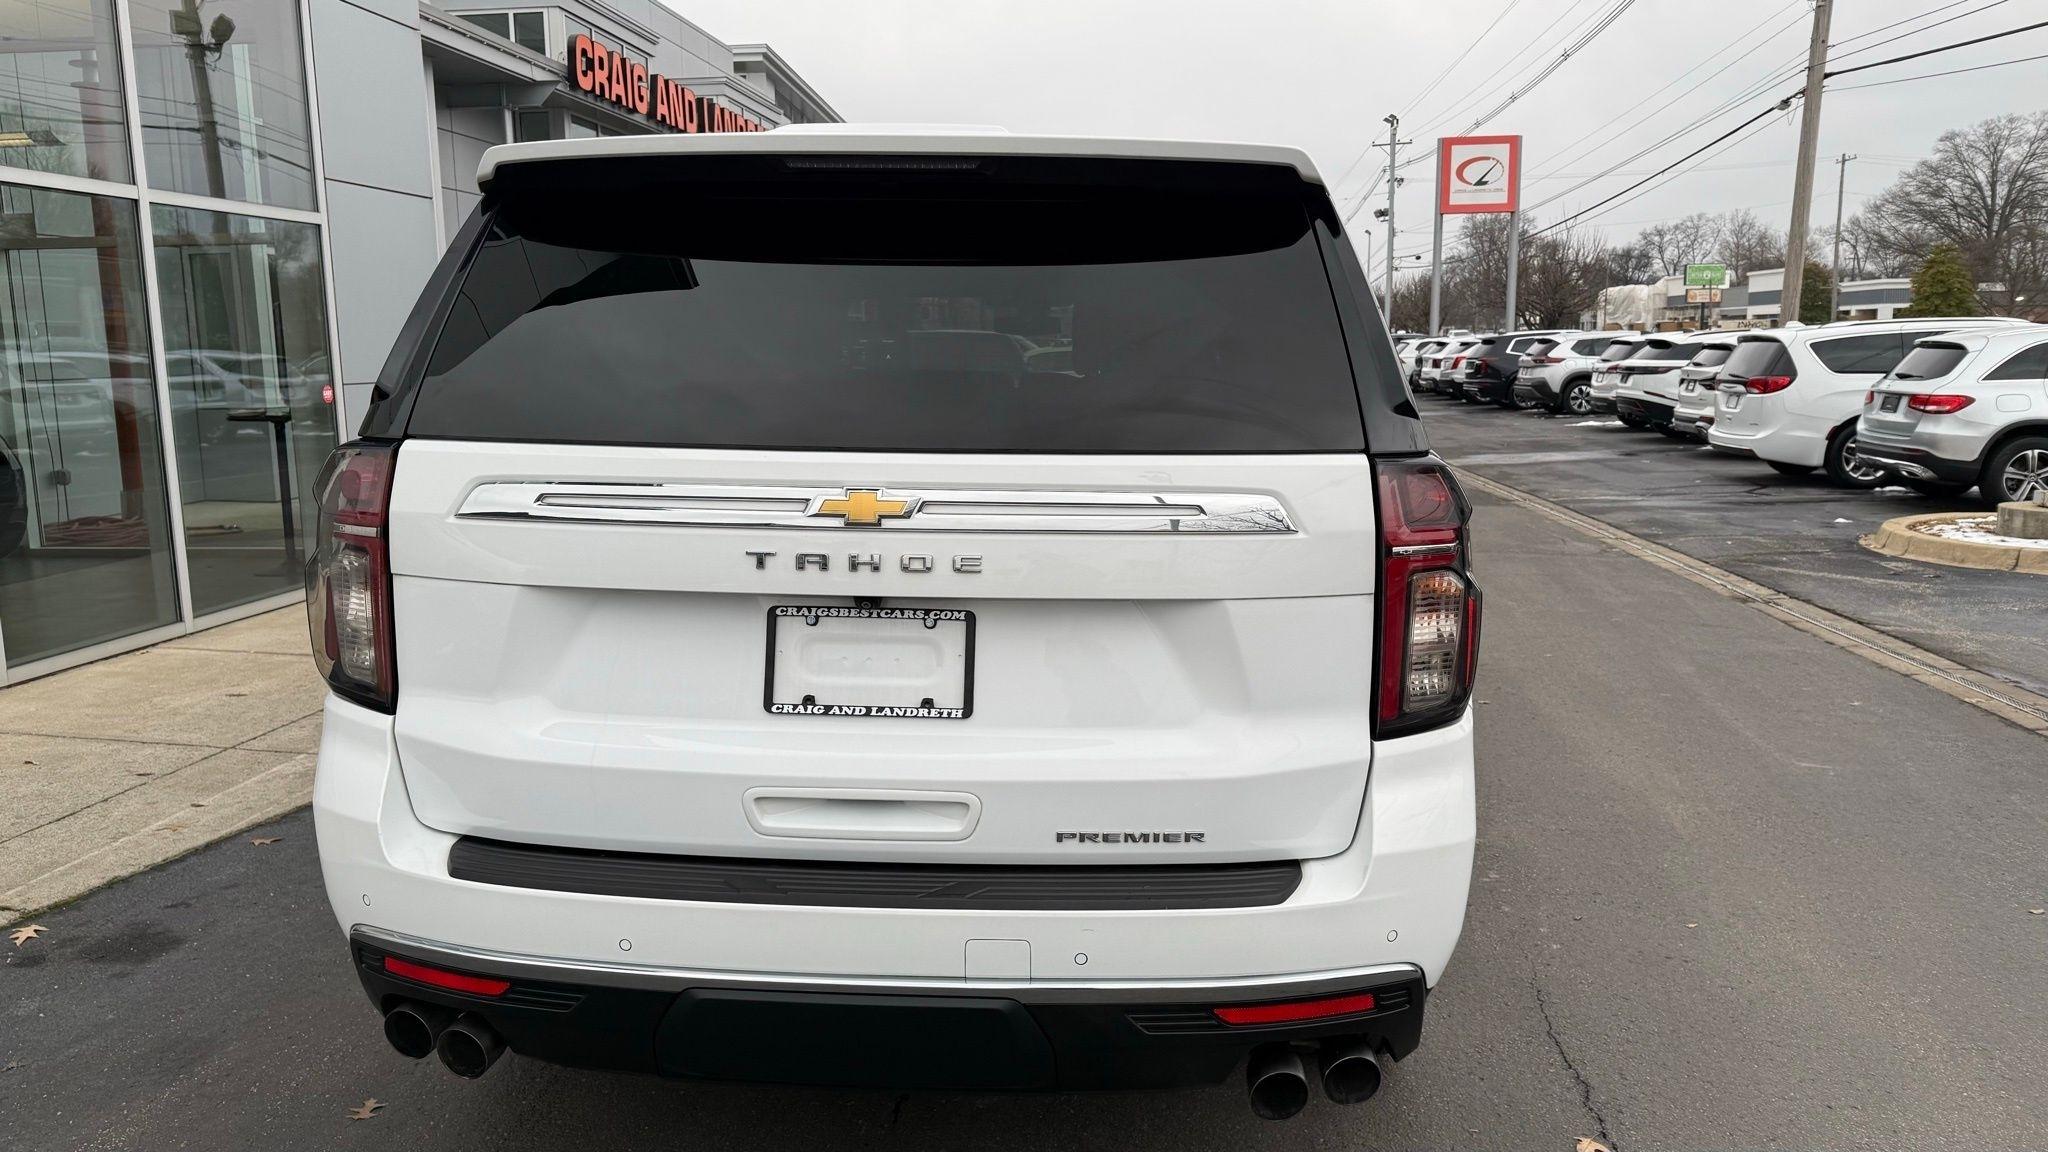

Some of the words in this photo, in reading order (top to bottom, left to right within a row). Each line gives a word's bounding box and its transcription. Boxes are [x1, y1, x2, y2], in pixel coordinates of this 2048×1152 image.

[572, 33, 650, 115] CRAIG
[654, 74, 699, 133] AND
[745, 551, 983, 573] TAHOE
[775, 606, 967, 621] CRAIGSBESTCARS.COM
[771, 704, 826, 715] CRAIG
[829, 705, 867, 716] AND
[870, 706, 963, 719] LANDRETH
[1056, 831, 1206, 844] PREMIER
